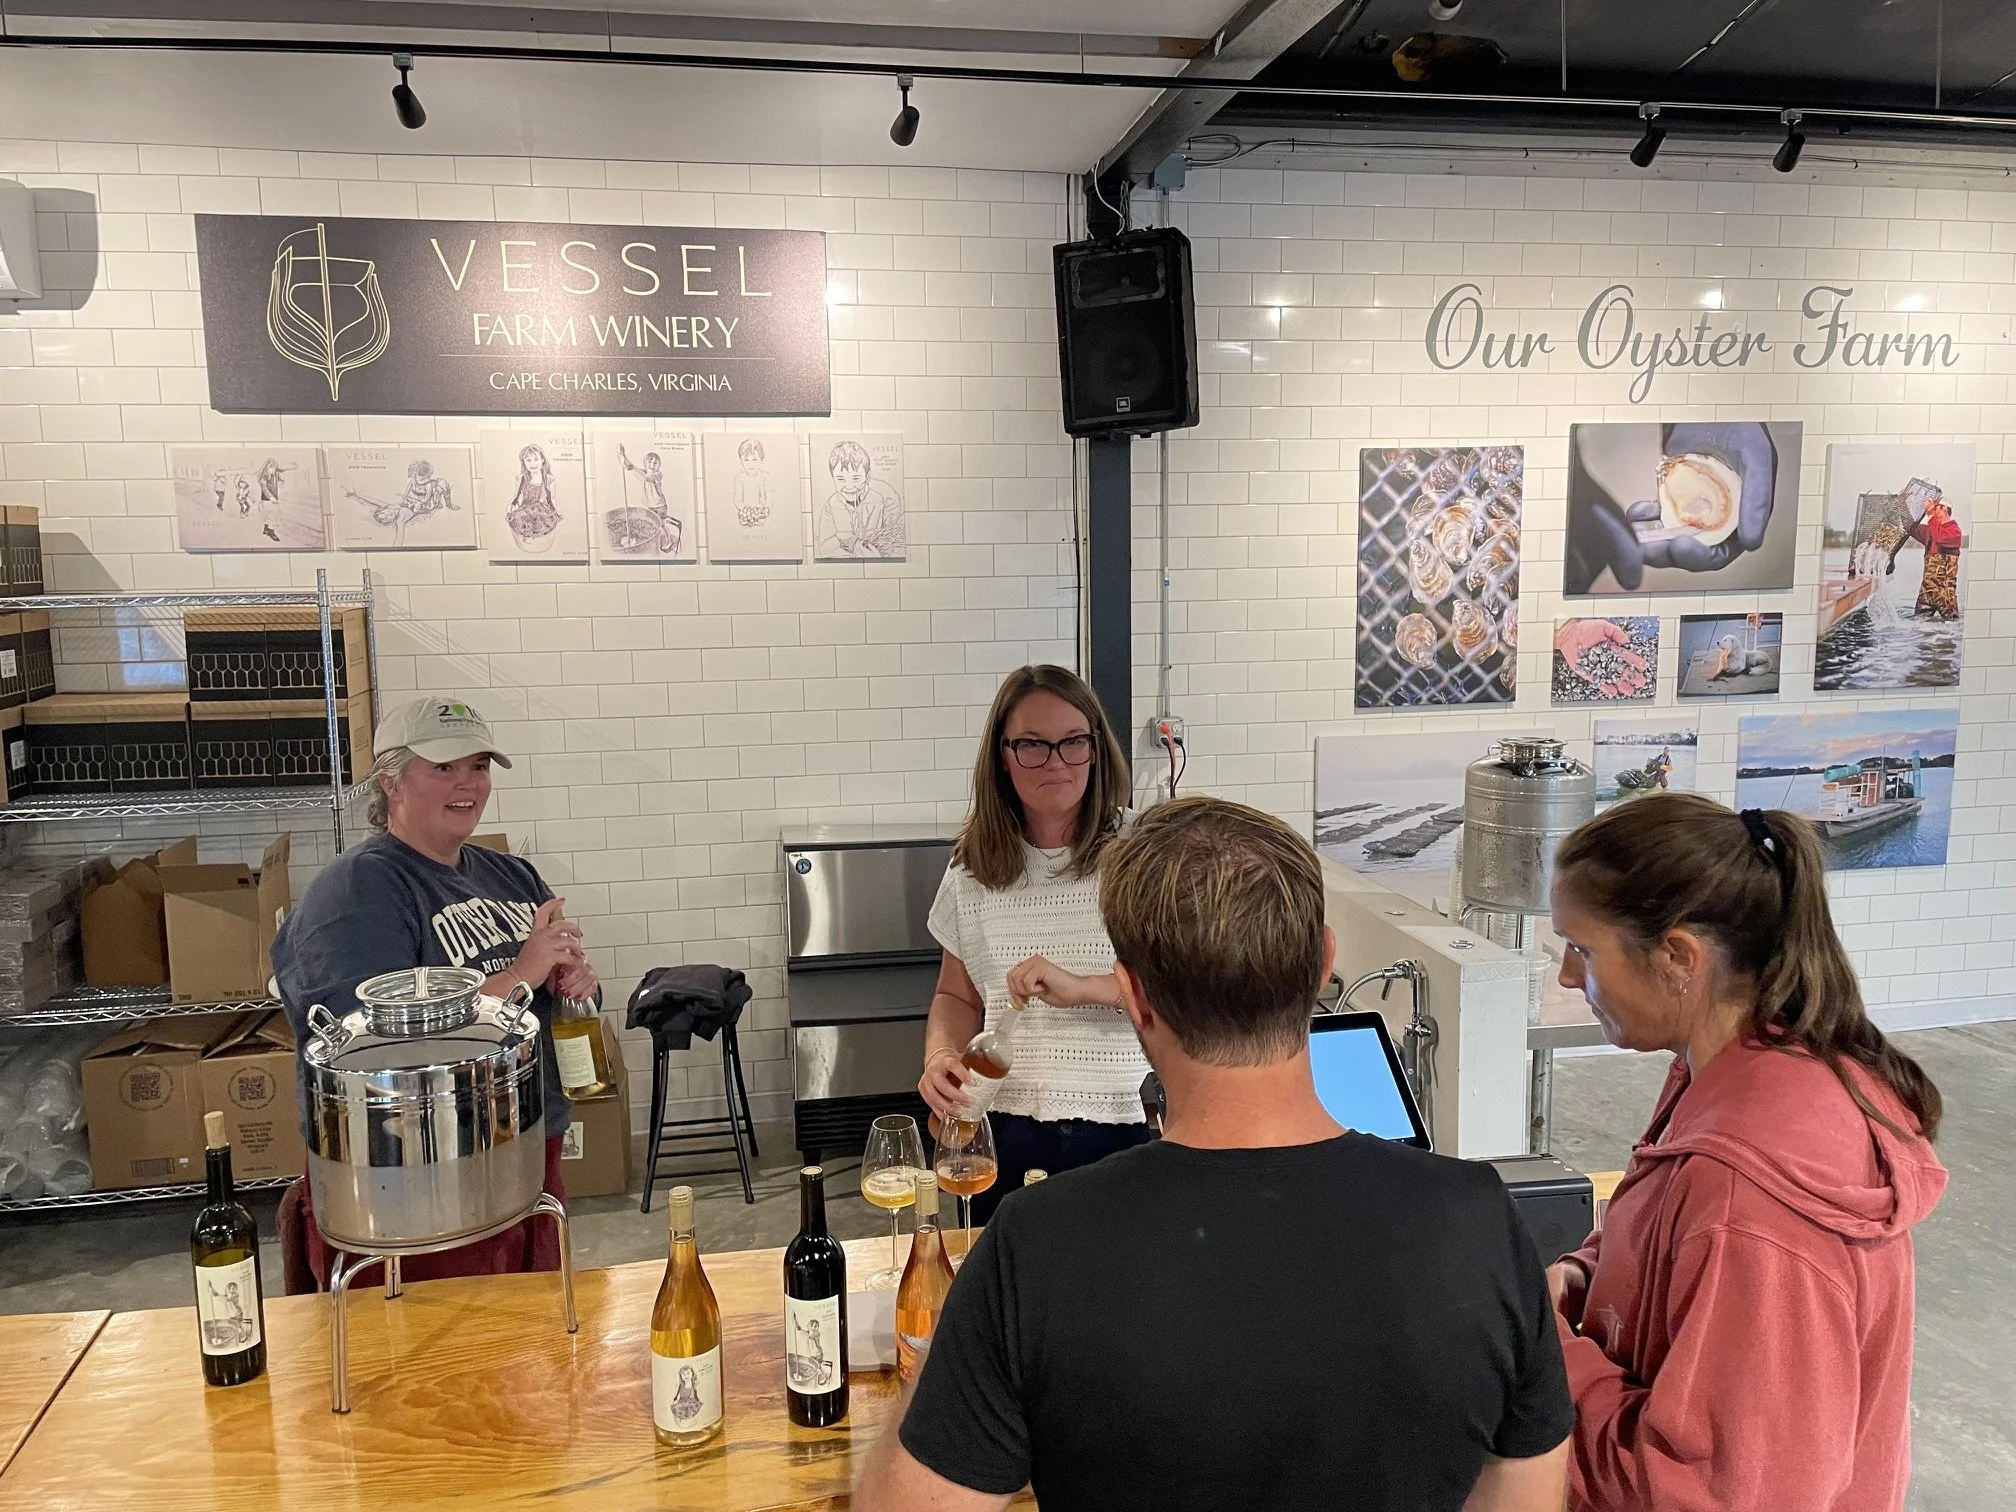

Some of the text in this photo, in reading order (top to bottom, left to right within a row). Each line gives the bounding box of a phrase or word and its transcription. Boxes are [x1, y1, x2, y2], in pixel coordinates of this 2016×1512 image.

[430, 238, 772, 299] VESSEL
[472, 313, 740, 349] FARM WINERY
[1425, 283, 1960, 404] Our Oyster Farm
[489, 371, 733, 393] CAPE CHARLES, VIRGINIA
[346, 452, 387, 461] VESSEL
[191, 520, 222, 528] VESSEL
